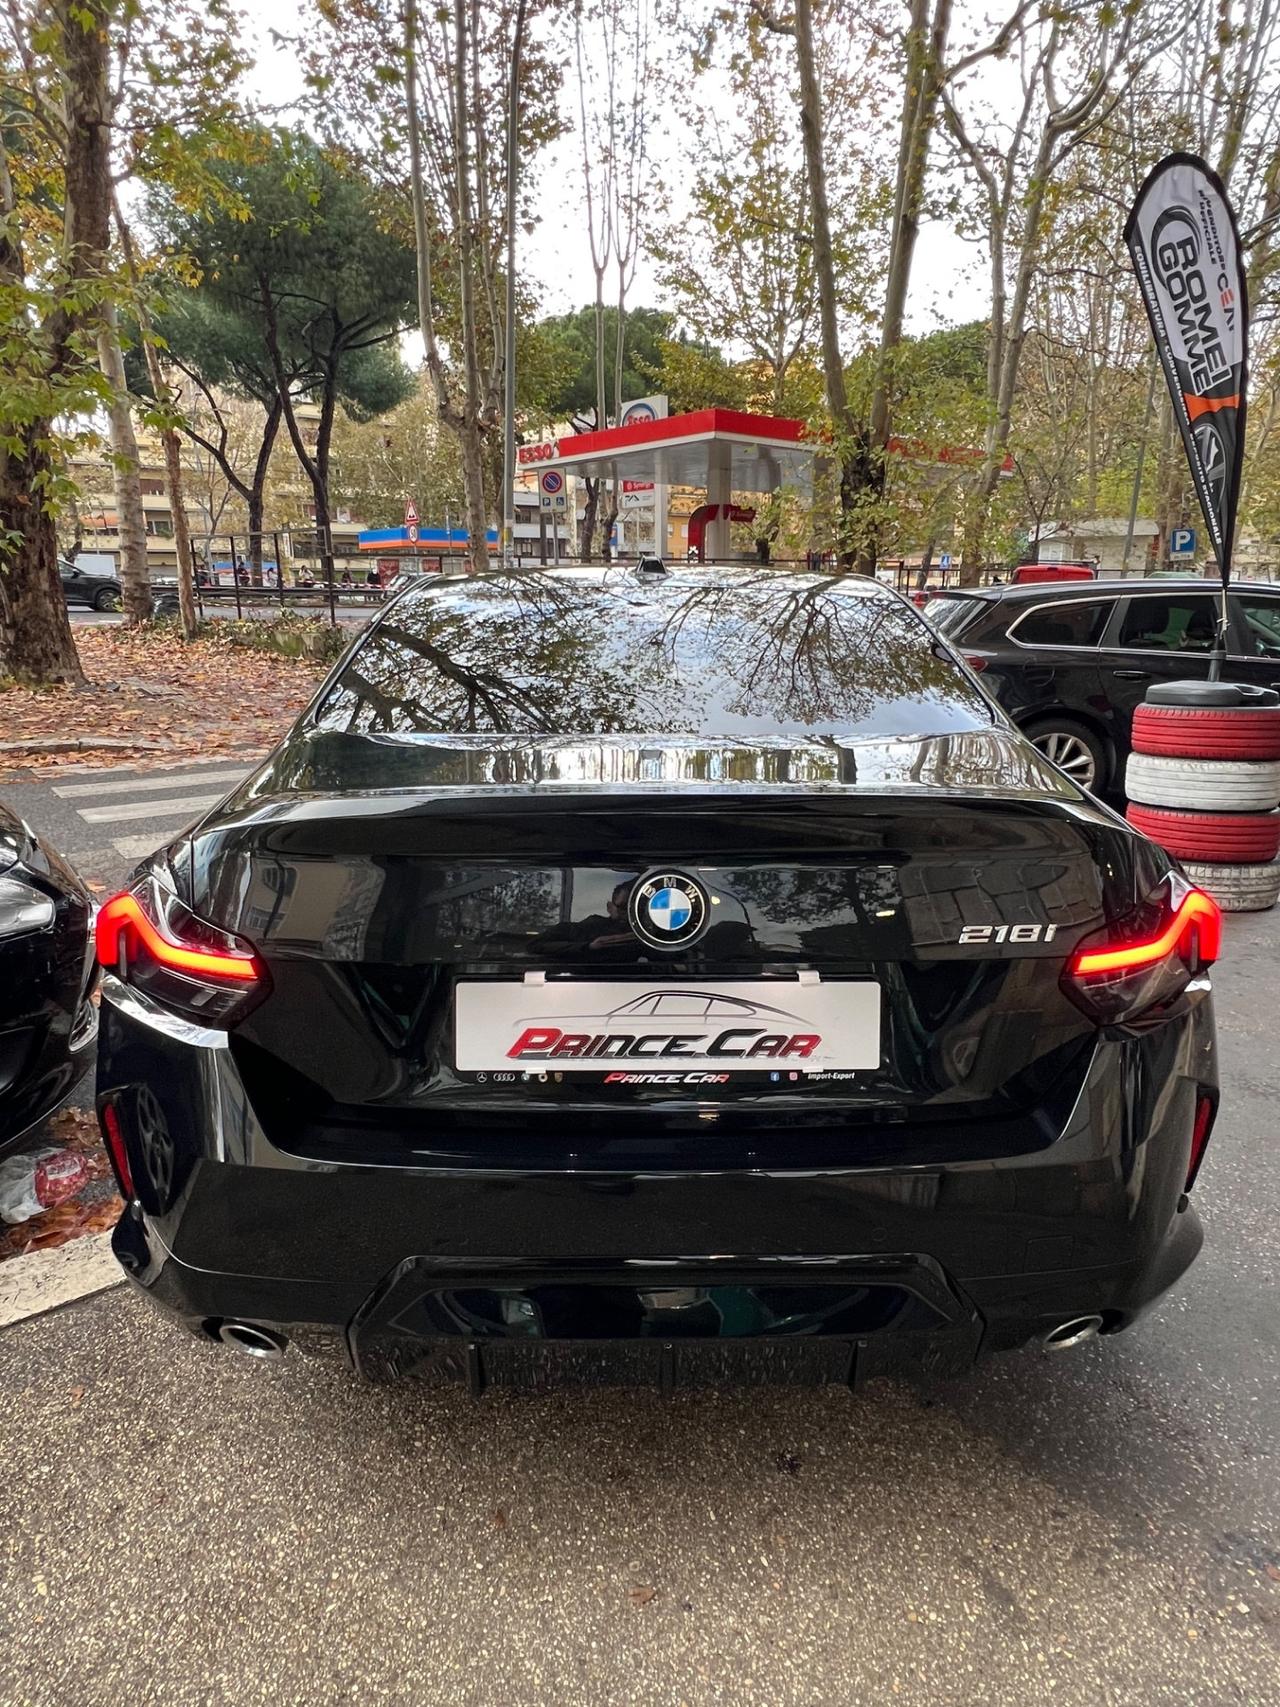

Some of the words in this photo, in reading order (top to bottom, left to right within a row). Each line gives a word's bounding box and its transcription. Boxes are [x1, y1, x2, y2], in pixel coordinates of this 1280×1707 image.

[1159, 242, 1211, 393] GOMME
[1176, 236, 1231, 383] ROMEI
[1134, 246, 1166, 337] EQUILIBRATURA
[1202, 485, 1222, 544] STAGIONALE
[1175, 531, 1191, 551] P
[641, 877, 699, 902] BMW
[958, 924, 1058, 944] 218i
[706, 1028, 823, 1058] CAR
